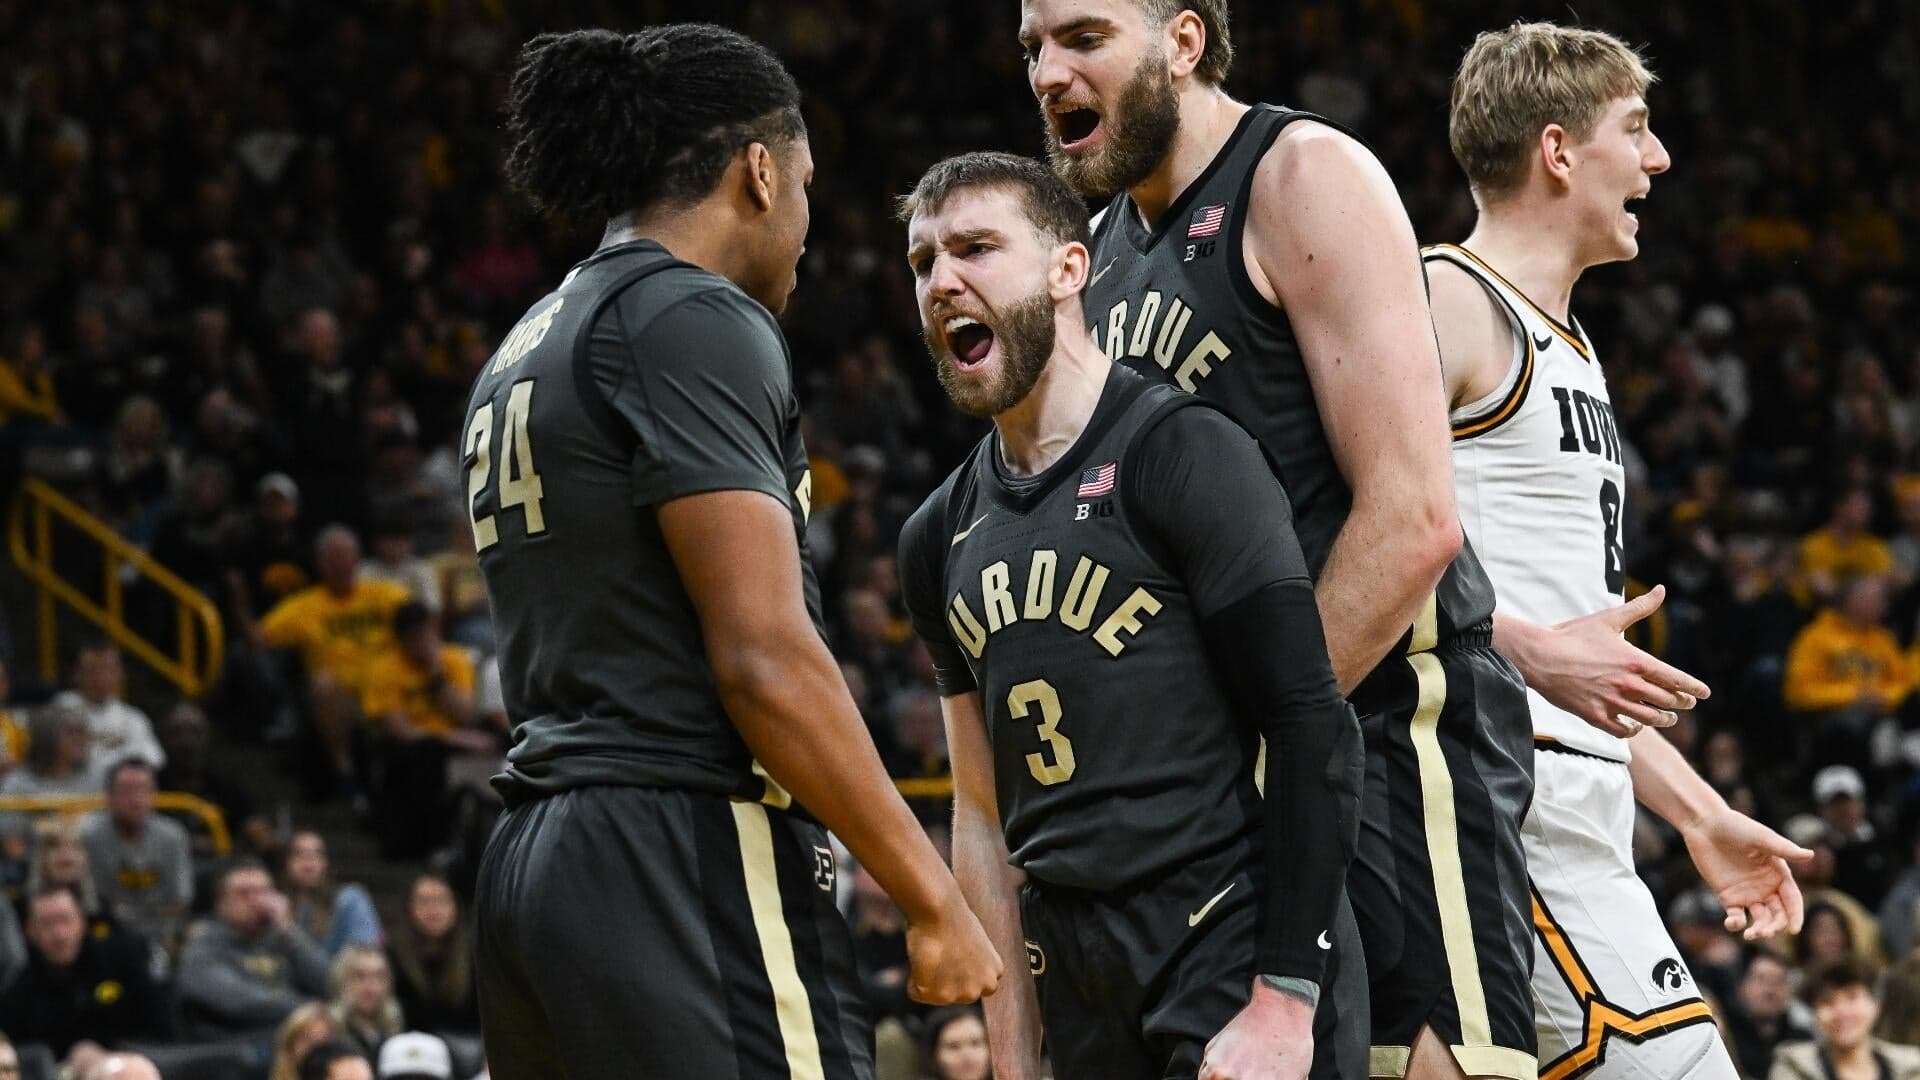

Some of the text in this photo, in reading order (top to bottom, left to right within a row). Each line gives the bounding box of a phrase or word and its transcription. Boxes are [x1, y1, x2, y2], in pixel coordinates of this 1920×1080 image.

[1090, 290, 1233, 395] RDUE
[464, 380, 546, 552] 24
[1550, 386, 1624, 467] IOW
[1599, 478, 1626, 597] 8
[948, 549, 1164, 658] URDUE
[1006, 678, 1077, 787] 3
